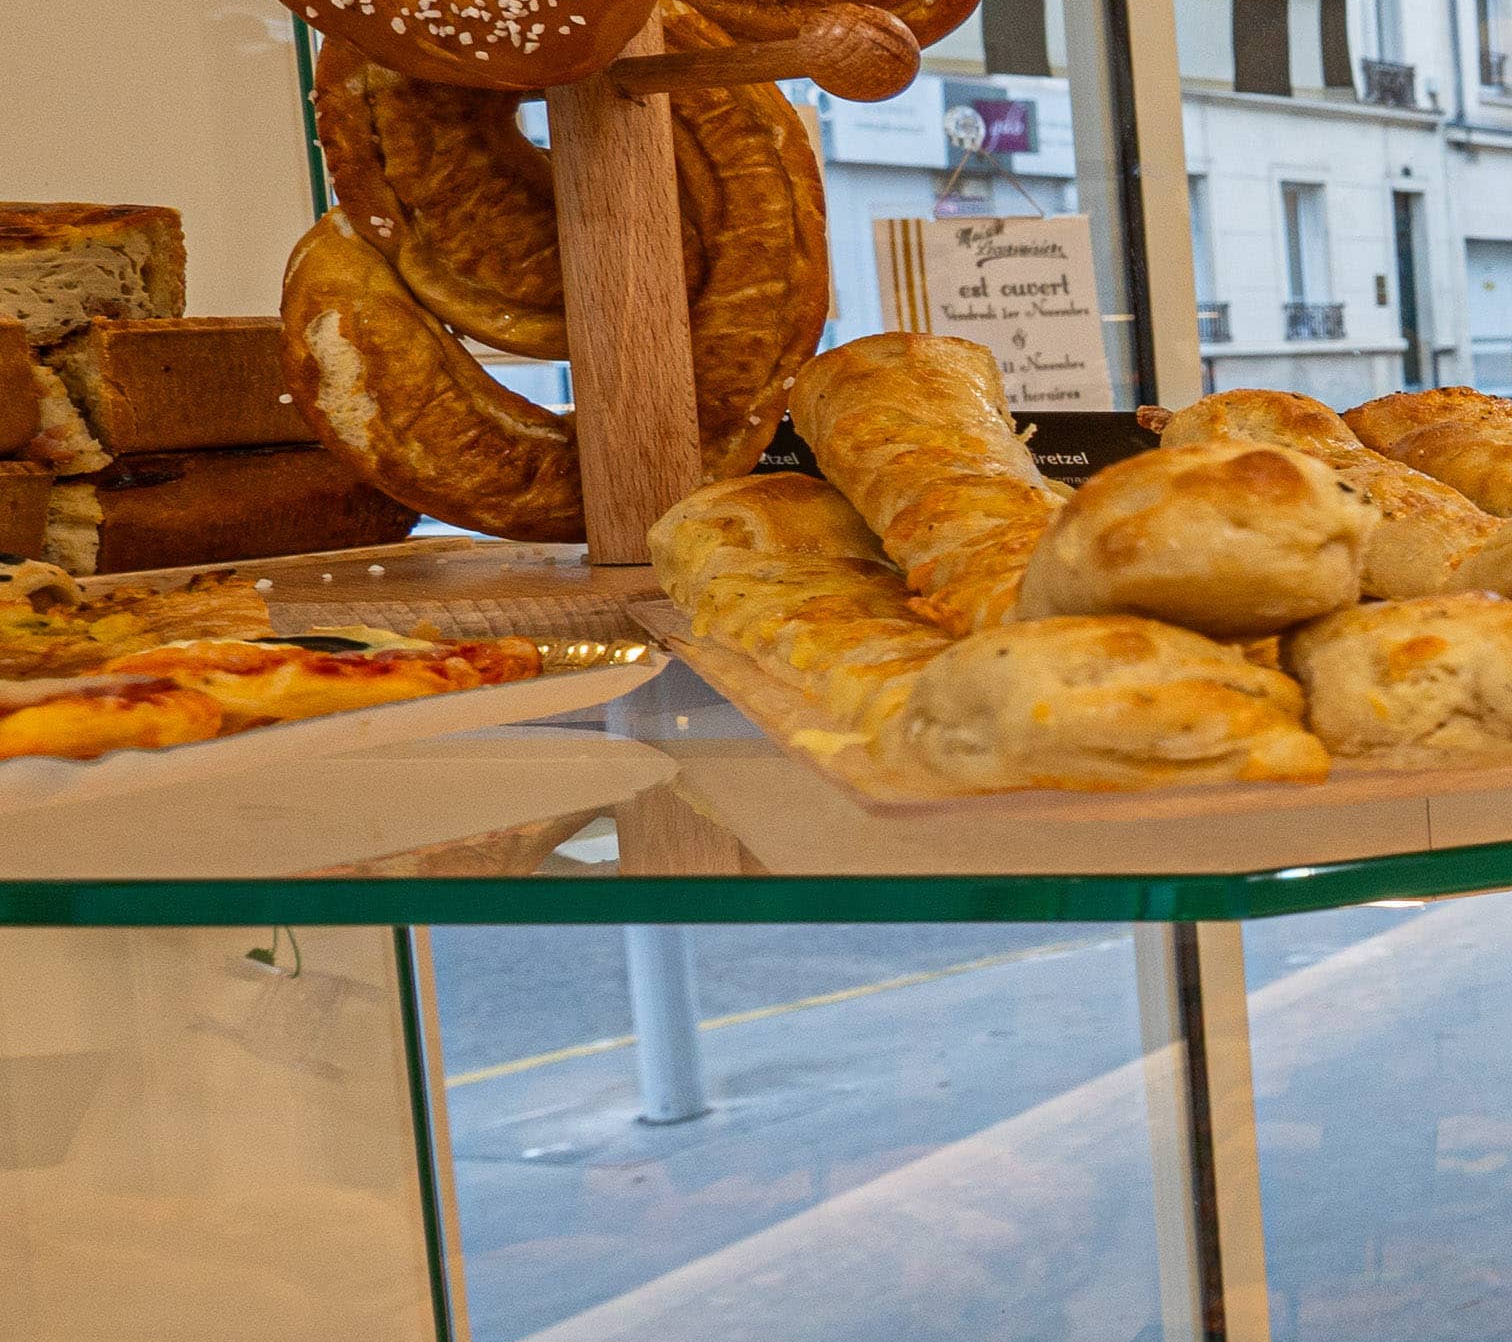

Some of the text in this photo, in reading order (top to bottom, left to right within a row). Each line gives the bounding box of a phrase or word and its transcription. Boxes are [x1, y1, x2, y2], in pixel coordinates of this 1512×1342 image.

[959, 277, 988, 298] est
[761, 452, 800, 465] etzel
[1035, 452, 1089, 465] retzel
